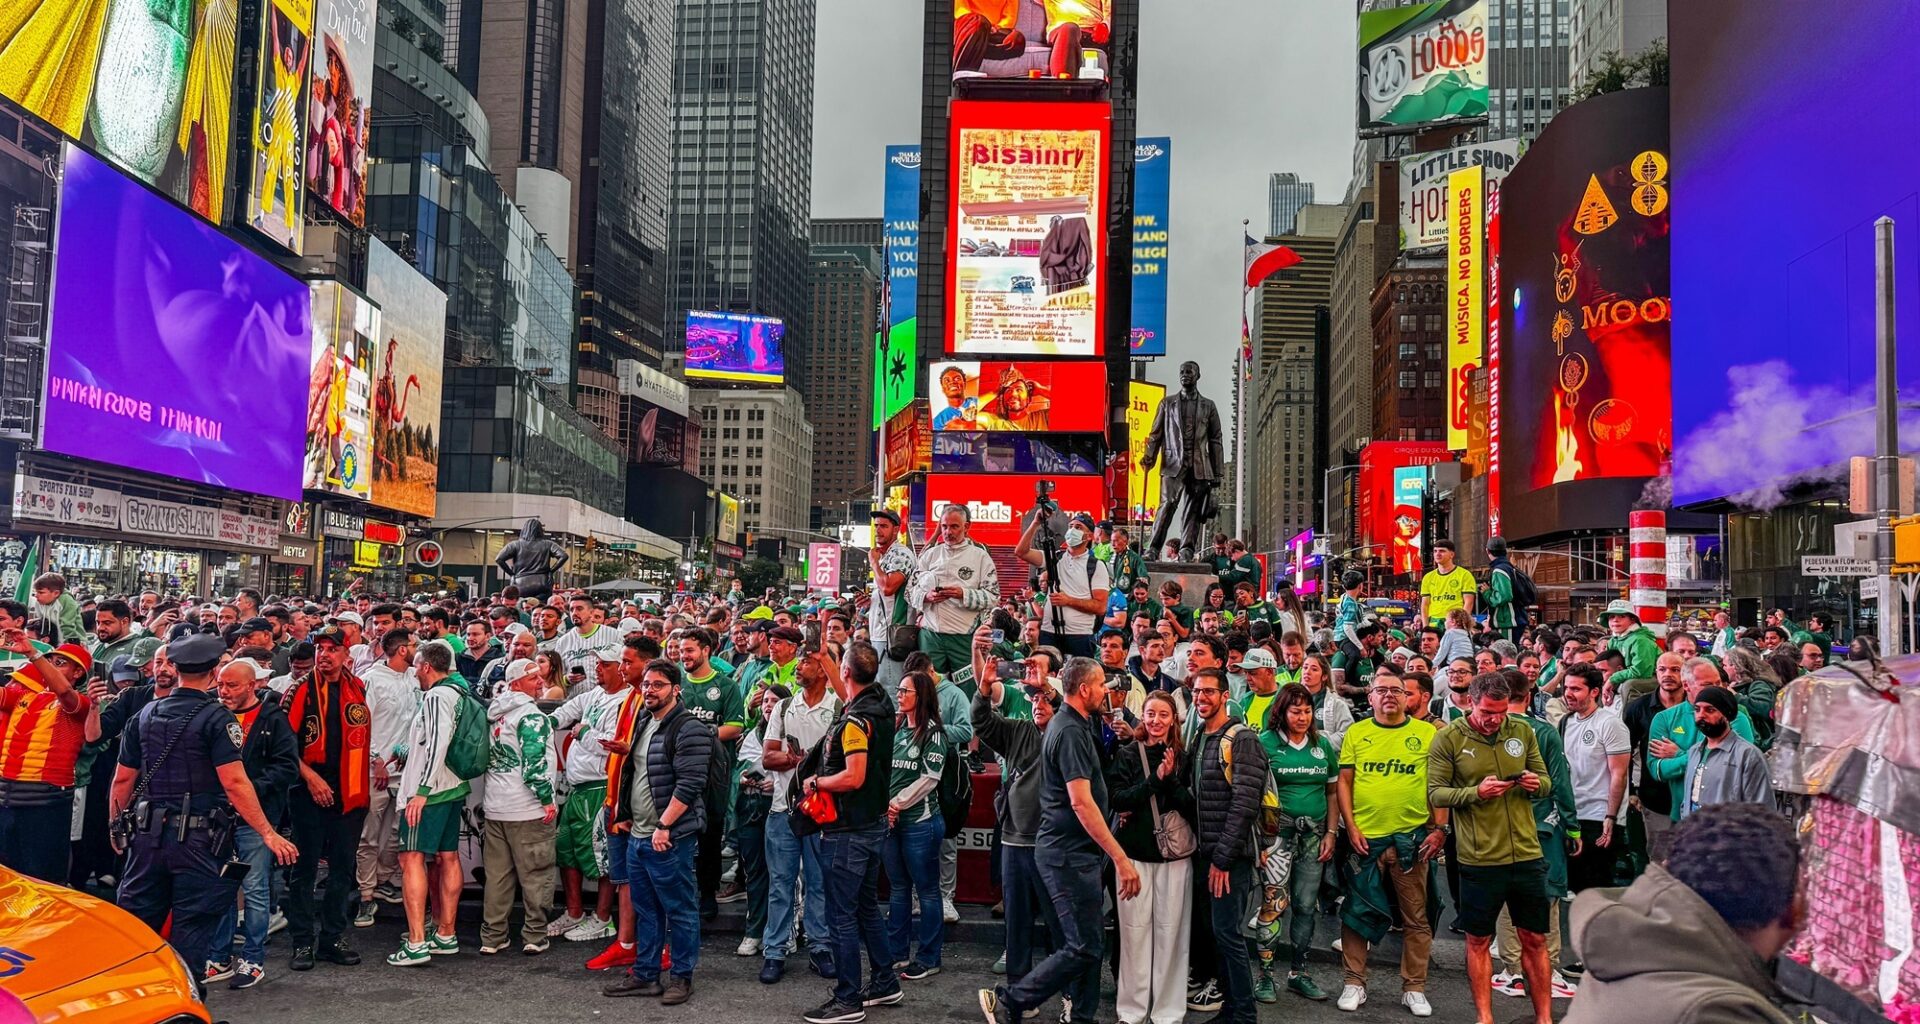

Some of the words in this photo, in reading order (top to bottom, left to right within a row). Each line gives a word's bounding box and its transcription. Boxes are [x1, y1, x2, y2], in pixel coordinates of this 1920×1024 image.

[327, 2, 350, 43] Dull
[1411, 150, 1468, 187] LITTLE
[1472, 149, 1515, 172] SHOP
[1458, 188, 1471, 256] BORDERS
[1458, 258, 1471, 280] NO
[689, 311, 725, 320] BROADWAY
[1490, 319, 1499, 362] FREE
[644, 378, 662, 395] HYATT
[1133, 396, 1149, 412] in
[1490, 368, 1499, 474] CHOCOLATE
[39, 480, 63, 495] SPORTS
[64, 484, 77, 496] FAN
[330, 511, 350, 528] BLUE
[352, 517, 364, 531] FIN
[815, 546, 836, 585] tkts
[1277, 766, 1328, 775] sportingbet
